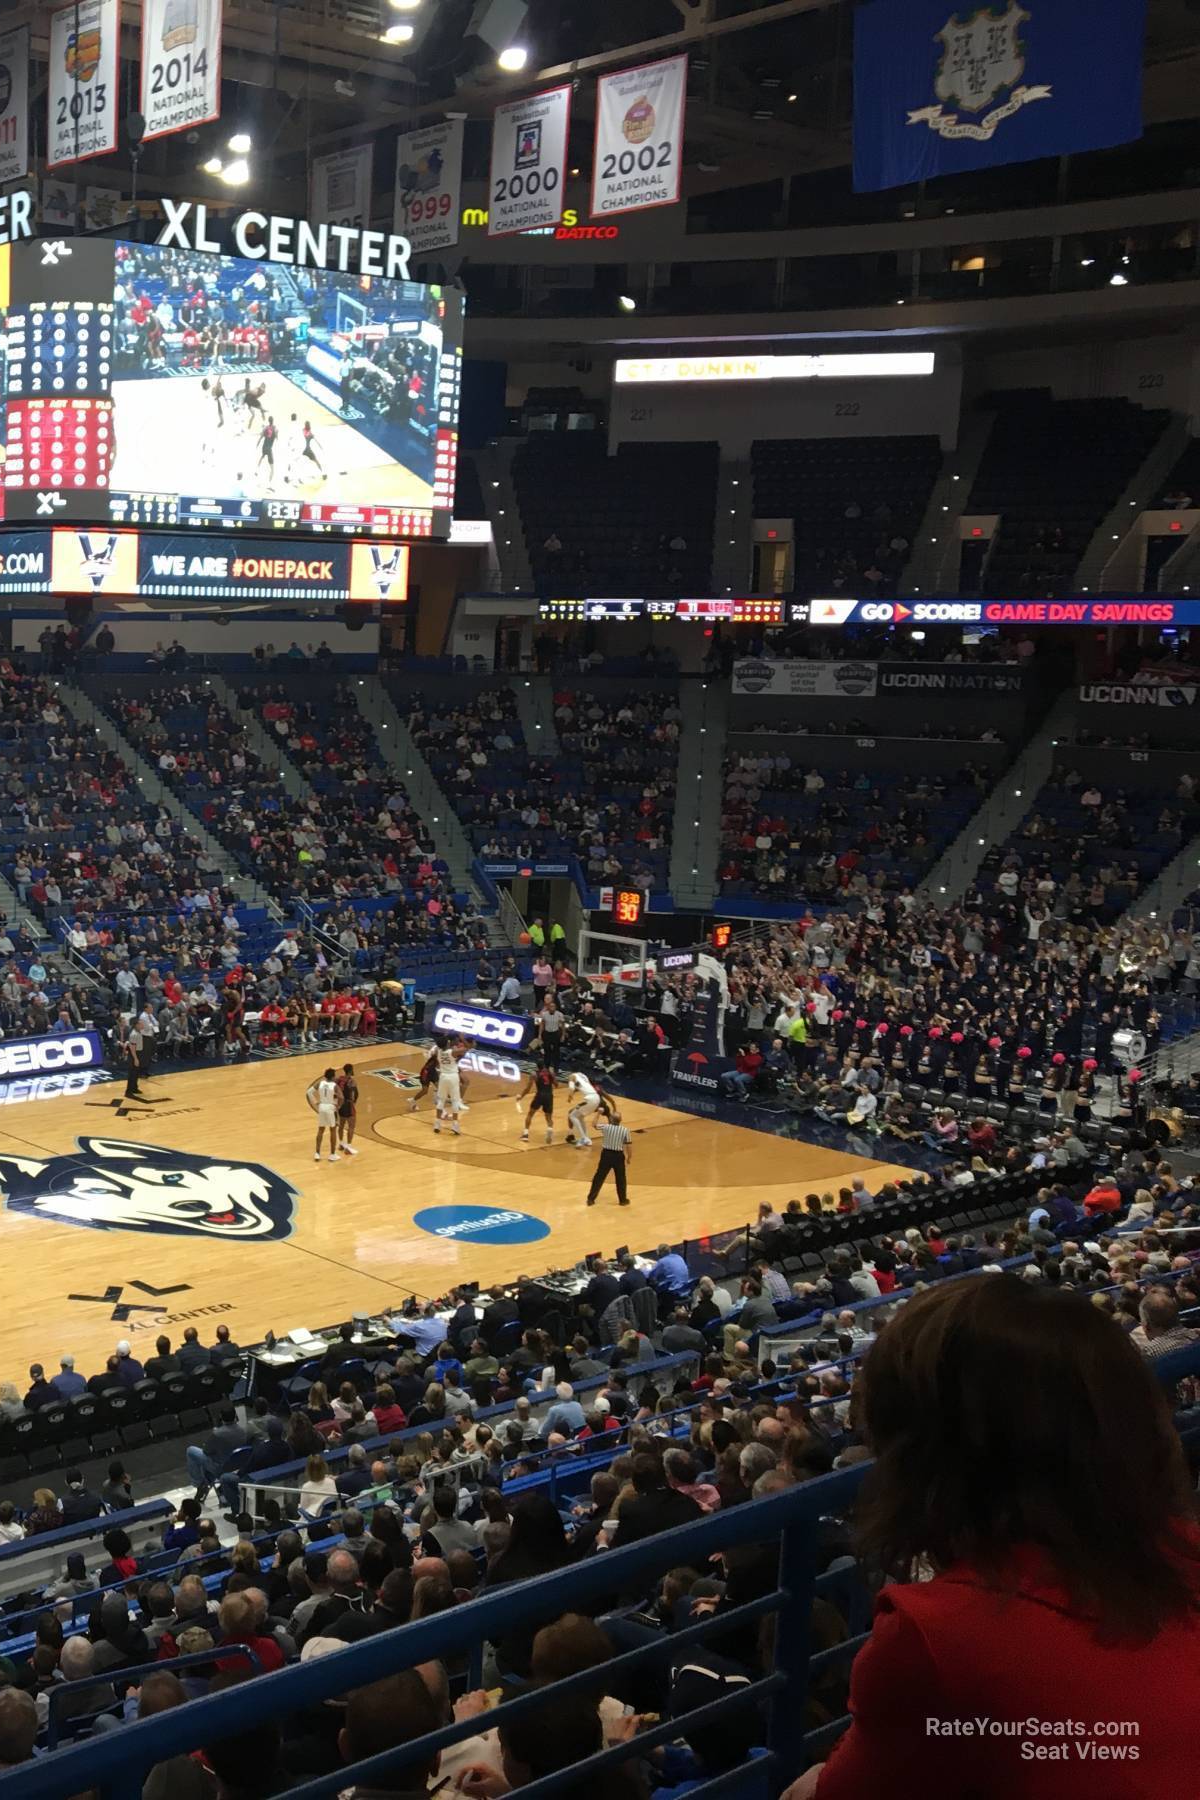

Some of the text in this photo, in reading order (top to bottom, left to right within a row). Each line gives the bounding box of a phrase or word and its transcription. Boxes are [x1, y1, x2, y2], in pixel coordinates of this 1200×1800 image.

[151, 48, 208, 95] 2014
[56, 84, 107, 125] 2013
[153, 87, 204, 113] NATIONAL
[149, 103, 209, 131] CHAMPIONS
[58, 120, 104, 142] NATONAL
[601, 141, 672, 180] 2002
[493, 167, 559, 202] 2000
[607, 175, 664, 194] NATIONAL
[500, 198, 550, 216] NATIONAL
[601, 189, 668, 211] CHAMPIONS
[495, 212, 554, 231] CHAMPIONS
[157, 198, 221, 253] XL
[235, 210, 413, 280] CENTER
[555, 227, 618, 239] DATTCO
[40, 240, 73, 265] XL
[32, 378, 41, 390] 2
[100, 378, 108, 390] 1
[1137, 374, 1164, 389] 223
[834, 403, 860, 417] 222
[36, 491, 67, 515] XL
[240, 501, 252, 516] 6
[152, 555, 333, 581] WE ARE #ONEPACK
[622, 602, 632, 612] 6
[687, 603, 698, 613] 11
[861, 603, 1174, 621] GO SCORE! GAME DAY SAVINGS
[882, 673, 946, 688] UCONN
[1080, 685, 1157, 704] UCONN
[1129, 752, 1149, 761] 121
[619, 903, 638, 921] 30
[663, 954, 693, 967] UCONN
[433, 1007, 524, 1045] GEICO
[672, 1070, 718, 1089] TRAVELERS
[434, 1211, 525, 1238] genius3D
[154, 1303, 238, 1325] CENTER
